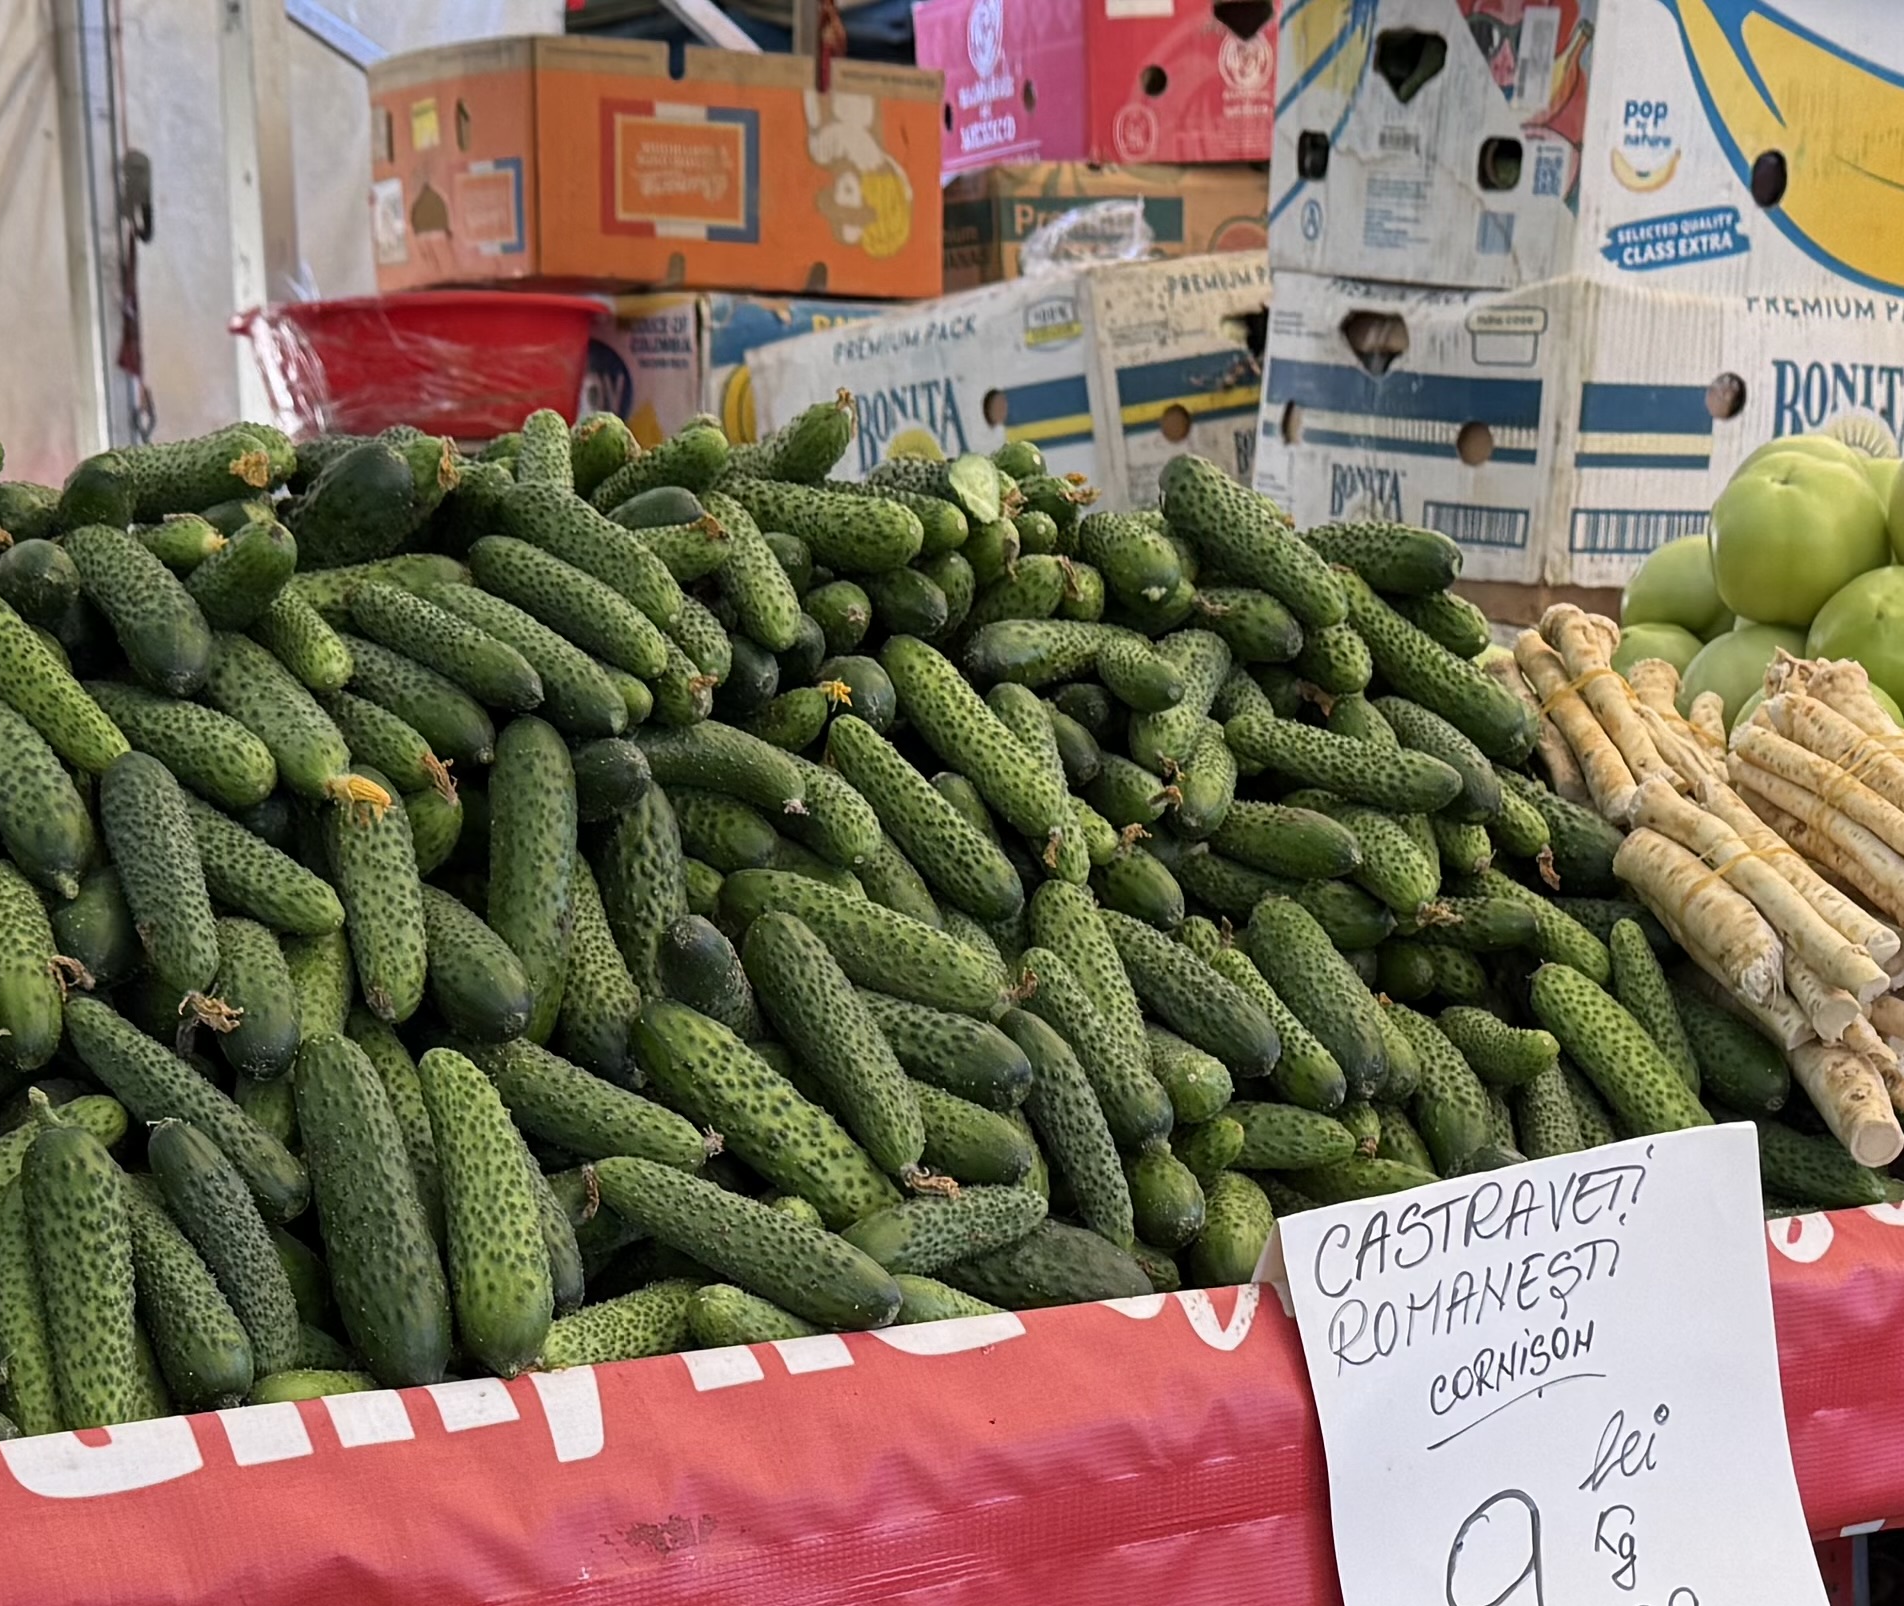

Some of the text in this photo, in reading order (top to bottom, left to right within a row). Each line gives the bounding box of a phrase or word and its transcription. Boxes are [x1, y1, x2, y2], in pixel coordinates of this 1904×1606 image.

[1624, 99, 1668, 126] pop
[1624, 130, 1671, 149] nature
[1617, 212, 1733, 245] SELECTED QUALITY
[1622, 232, 1733, 266] CLASS EXTRA
[833, 326, 920, 364] PREMIUM
[925, 314, 978, 344] PACK
[855, 376, 972, 475] BONITA
[1331, 463, 1402, 522] BONITA
